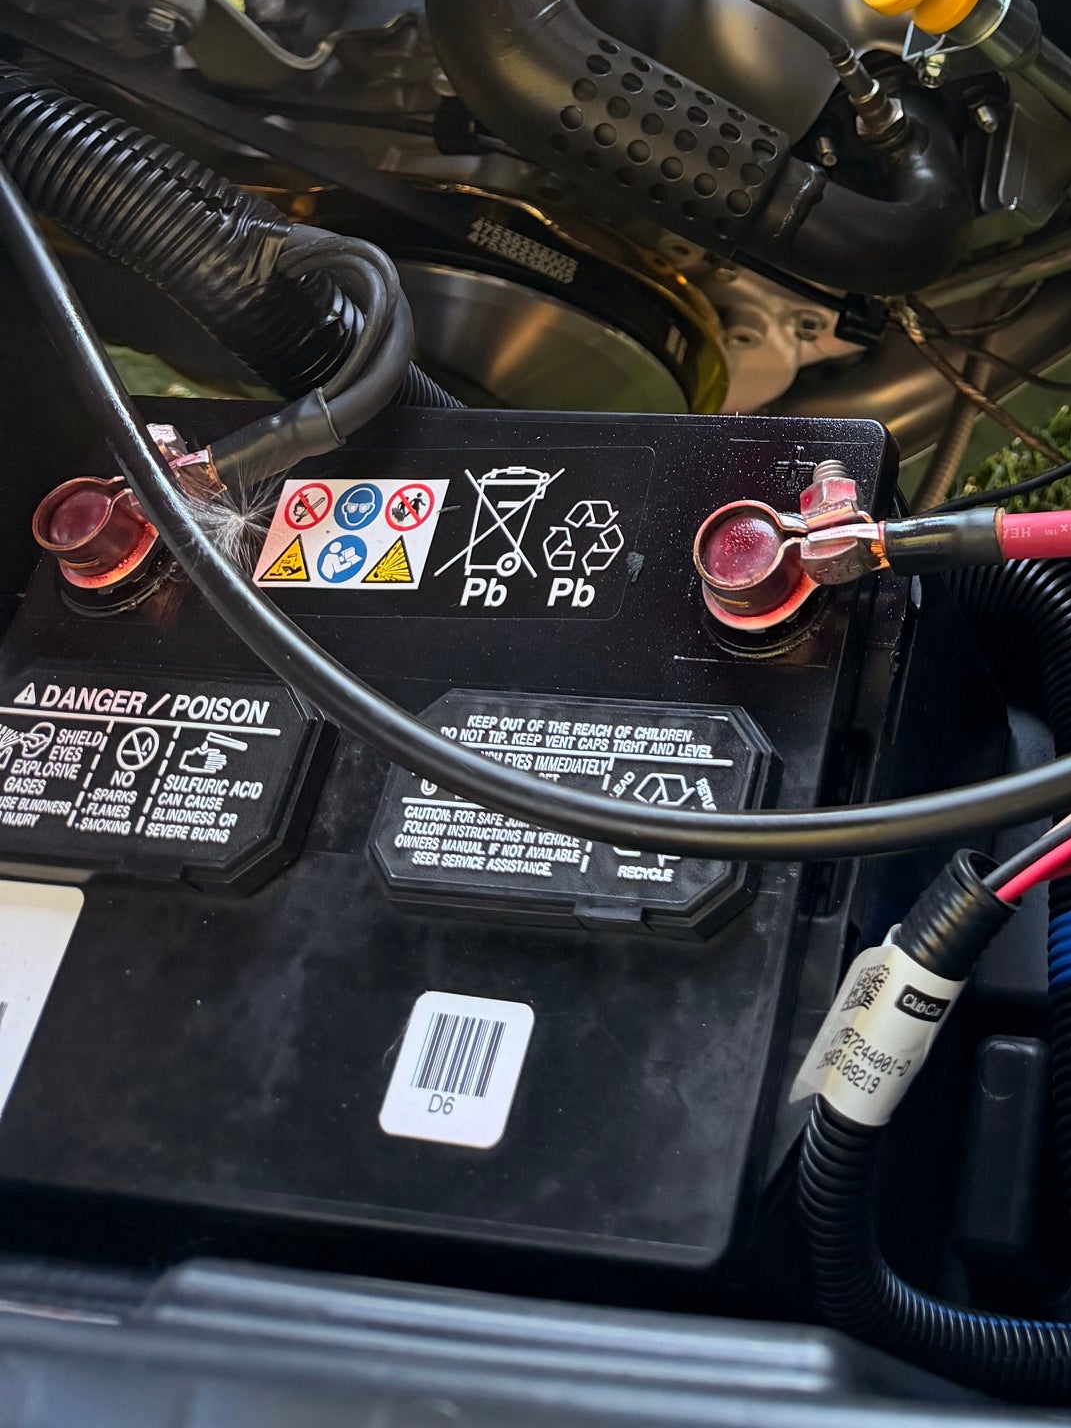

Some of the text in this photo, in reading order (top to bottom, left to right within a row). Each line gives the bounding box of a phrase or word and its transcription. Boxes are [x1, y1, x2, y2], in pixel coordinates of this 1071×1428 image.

[461, 574, 595, 609] Pb Pb
[39, 684, 148, 715] DANGER
[170, 694, 270, 724] POISON
[56, 728, 102, 747] SHIELD
[466, 715, 693, 742] KEEP OUT OF THE REACH OF CHILDREN.
[49, 745, 84, 762] EYES
[459, 728, 485, 741] NOT
[488, 729, 508, 744] TIP.
[511, 732, 542, 746] KEEP
[545, 734, 576, 748] VENT
[577, 737, 609, 751] CAPS
[612, 739, 647, 753] TIGHT
[648, 742, 674, 755] AND
[677, 743, 712, 758] LEVEL.
[11, 758, 81, 781] EXPLOSIVE
[504, 752, 533, 770] EYES
[534, 755, 608, 774] IMMEDIATELY
[3, 776, 47, 795] GASES
[110, 770, 136, 787] NO
[163, 774, 263, 800] SULFURIC ACID
[18, 796, 72, 816] BLINDNESS
[157, 792, 224, 811] CAN CAUSE
[2, 810, 40, 828] INJURY
[151, 807, 216, 824] BLINDNESS
[404, 805, 450, 821] CAUTION:
[452, 809, 475, 823] FOR
[476, 811, 503, 826] SAFE
[145, 822, 230, 844] SEVERE BURNS
[402, 819, 579, 847] FOLLOW INSTRUCTIONS IN VEHICLE
[394, 833, 580, 862] OWNERS MANUAL. IF NOT AVAILABLE
[412, 850, 551, 876] SEEK SERVICE ASSISTANCE.
[617, 865, 673, 881] RECYCLE
[902, 993, 927, 1014] Club
[427, 1095, 457, 1117] D6
